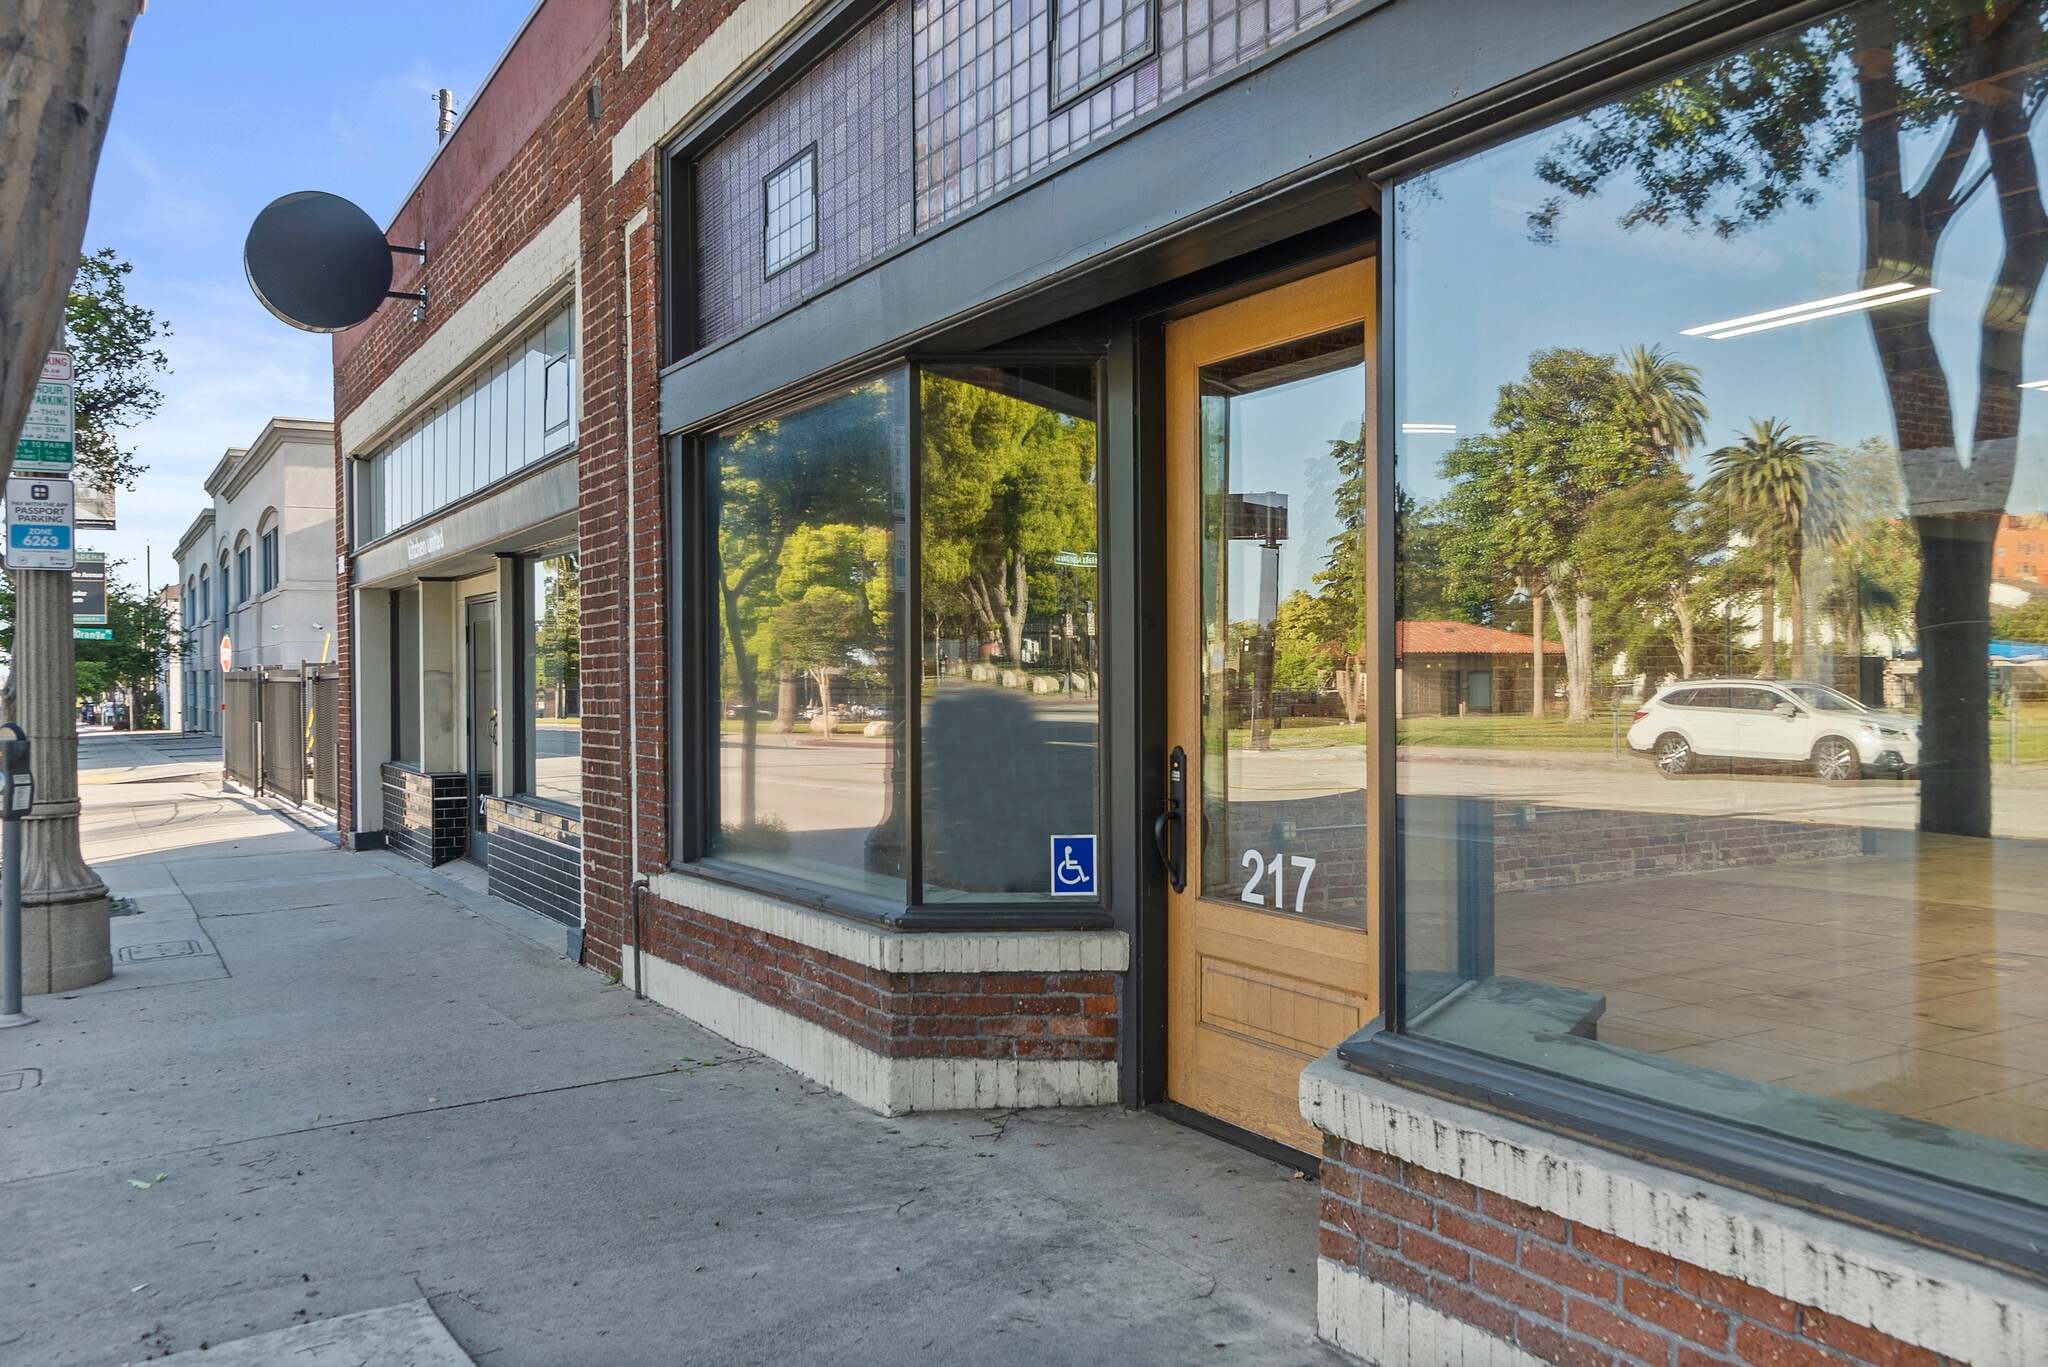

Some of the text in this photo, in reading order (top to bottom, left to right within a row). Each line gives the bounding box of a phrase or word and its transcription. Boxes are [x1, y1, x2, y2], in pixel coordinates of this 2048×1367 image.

[45, 358, 67, 366] KING
[15, 507, 66, 515] PASSPORT
[18, 515, 63, 524] PARKING
[23, 535, 59, 547] 6263
[76, 630, 106, 640] Orange
[1241, 849, 1316, 913] 217
